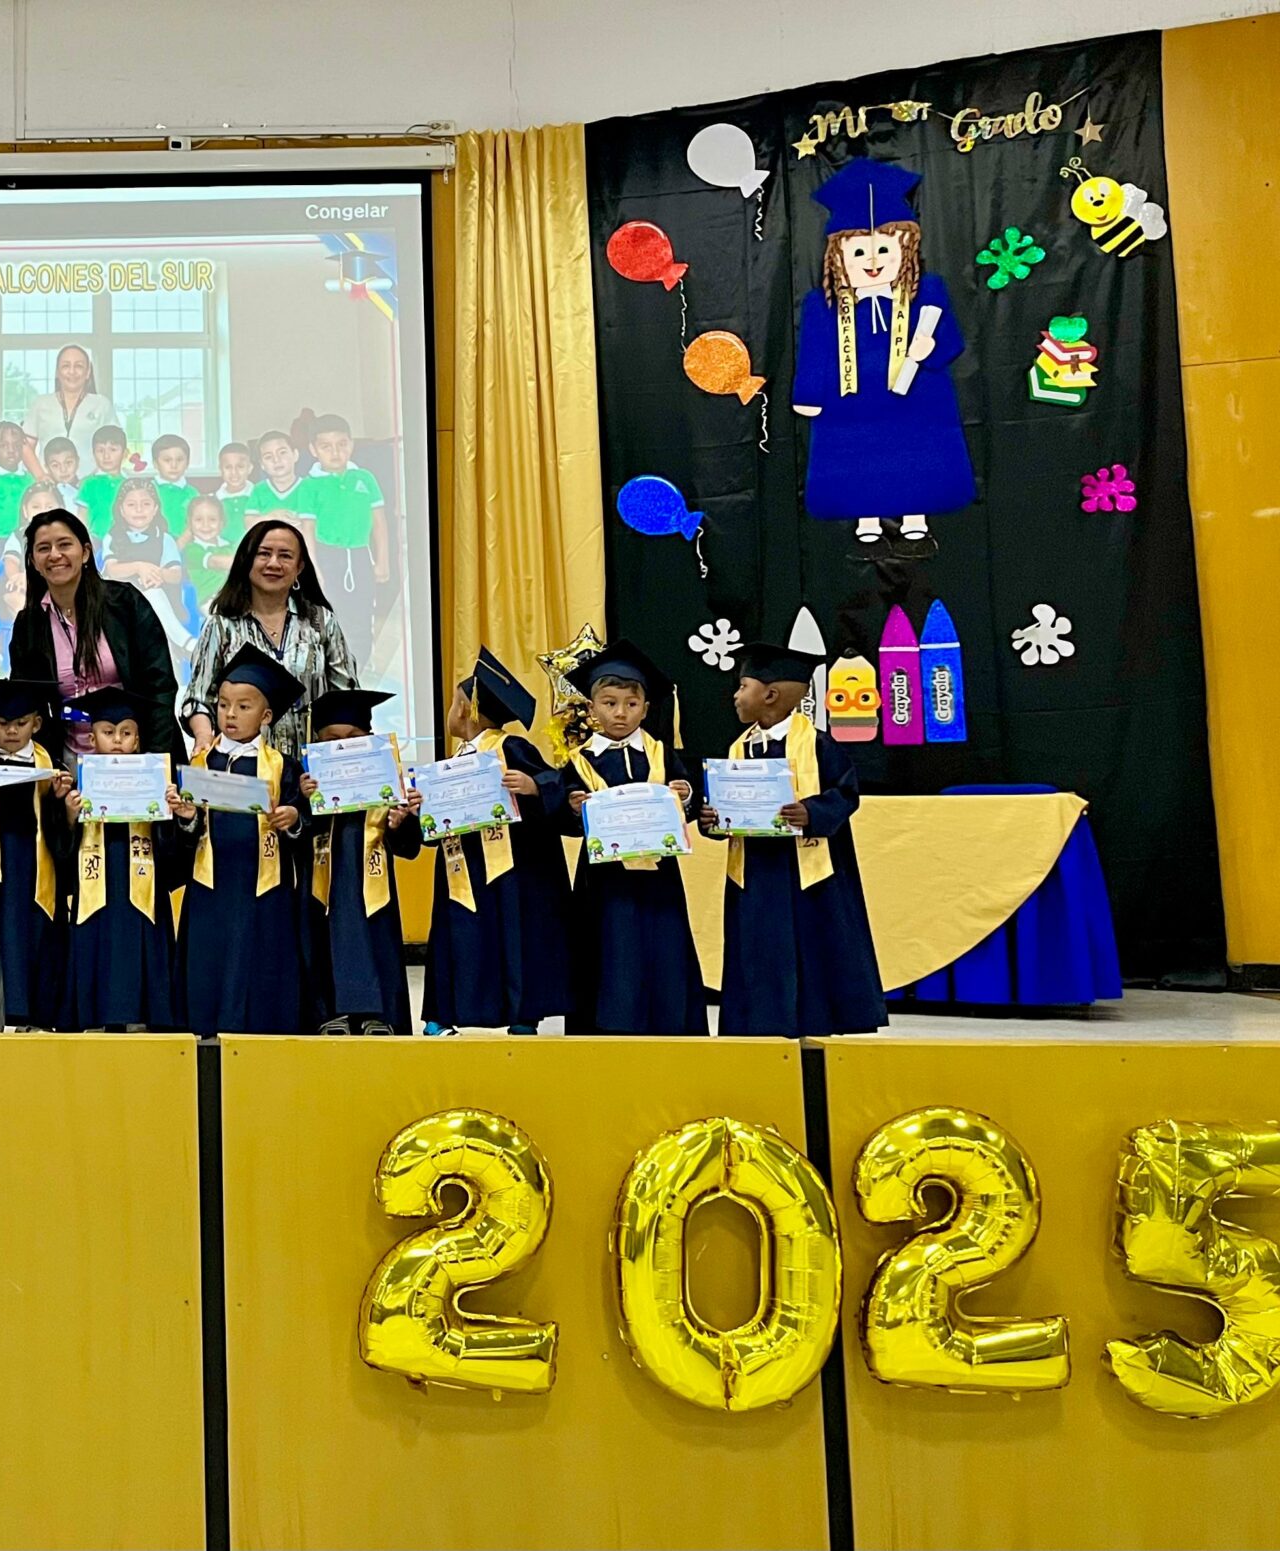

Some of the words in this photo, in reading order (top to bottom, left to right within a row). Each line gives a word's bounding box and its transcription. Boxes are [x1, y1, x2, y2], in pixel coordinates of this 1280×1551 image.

[950, 91, 1063, 152] Grado
[305, 202, 389, 221] Congelar
[108, 261, 157, 292] DEL
[161, 260, 213, 292] SUR
[840, 296, 852, 391] COMFACAUCA
[895, 310, 905, 357] AIPI
[894, 674, 910, 725] Crayola
[936, 669, 953, 723] Crayola
[358, 1105, 1280, 1420] 2025
